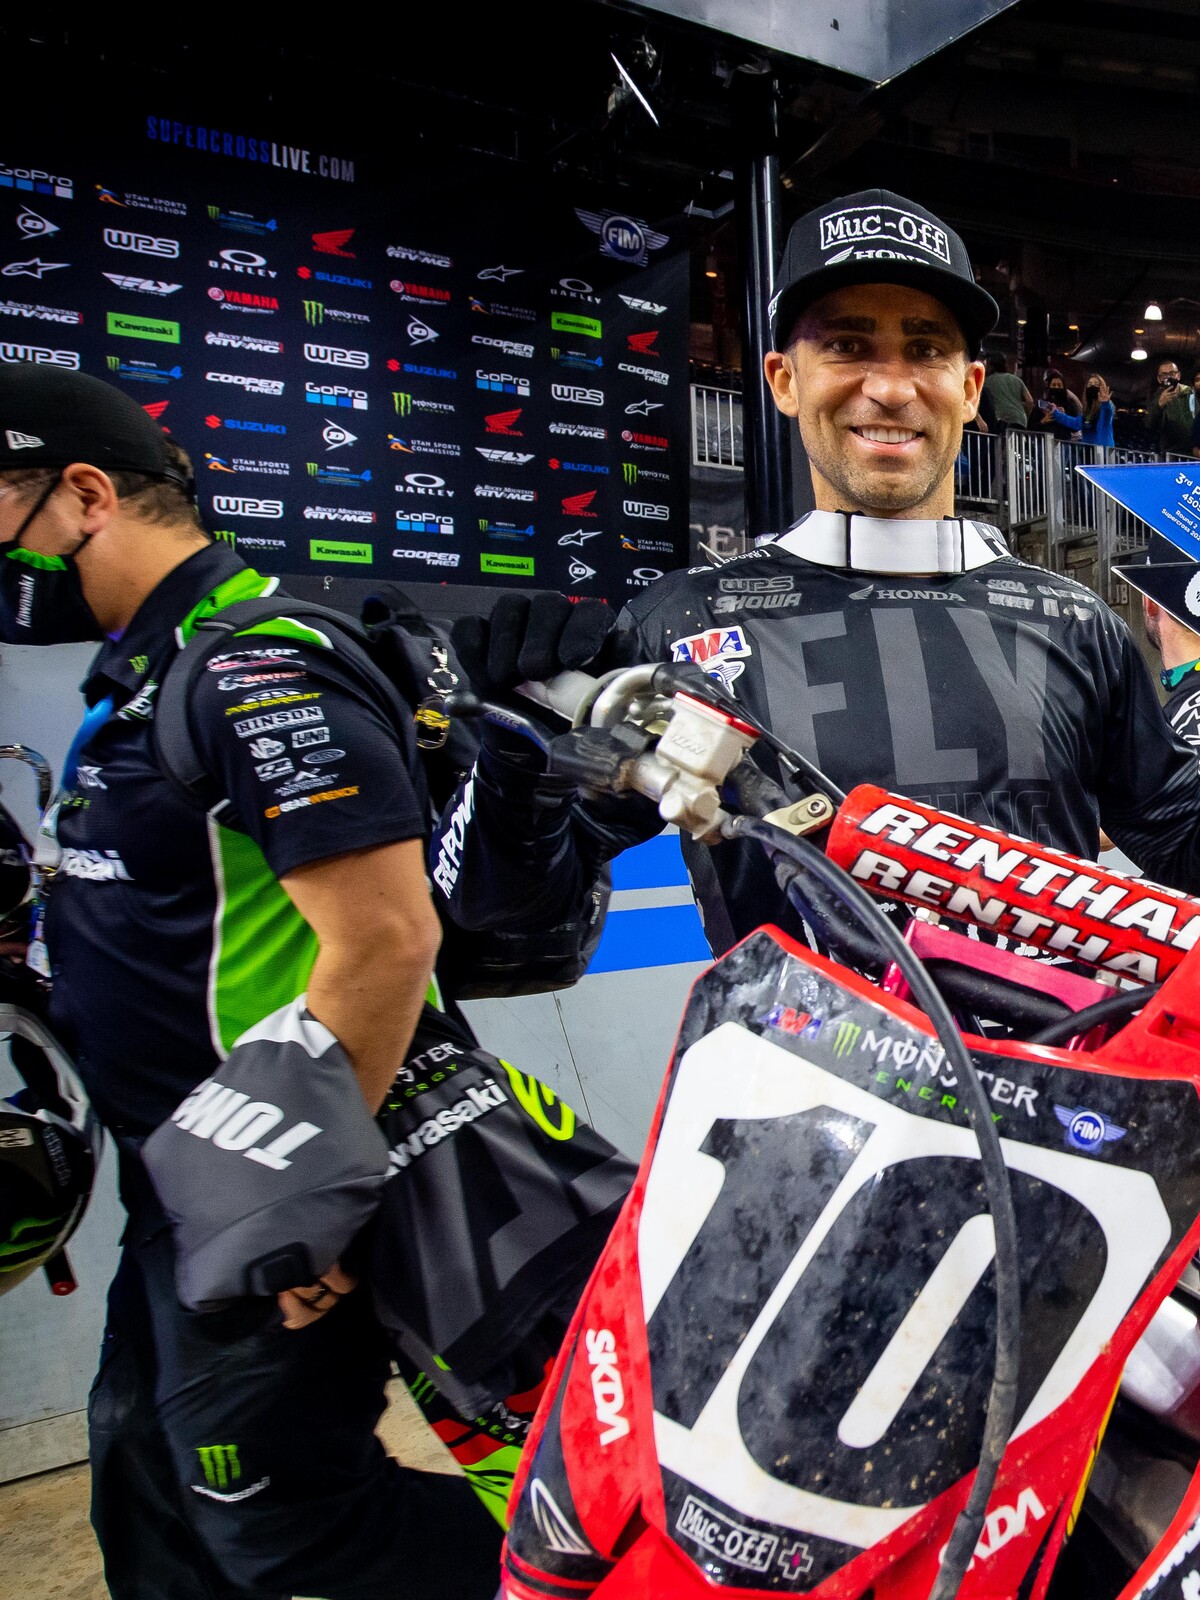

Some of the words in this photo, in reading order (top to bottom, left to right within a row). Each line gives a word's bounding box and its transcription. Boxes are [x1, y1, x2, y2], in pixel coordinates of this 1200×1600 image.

[147, 115, 354, 182] SUPERCROSSLIVE.COM
[103, 228, 179, 258] WPS
[608, 228, 639, 249] FIM
[825, 214, 949, 257] Muc-Off
[209, 260, 277, 278] OAKLEY
[315, 272, 372, 289] SUZUKI
[225, 289, 278, 310] YAMAHA
[405, 283, 450, 300] YAMAHA
[114, 319, 173, 336] Kawasaki
[556, 318, 598, 332] Kawasaki
[471, 335, 534, 351] COOPER
[305, 343, 369, 370] WPS
[404, 363, 456, 379] SUZUKI
[476, 370, 530, 387] GoPro
[618, 363, 669, 379] COOPER
[205, 371, 285, 389] COOPER
[306, 382, 368, 399] GoPro
[552, 384, 604, 406] WPS
[412, 399, 455, 412] MONSTER
[224, 419, 287, 434] SUZUKI
[411, 439, 430, 447] UTAH
[433, 442, 461, 451] SPORTS
[411, 445, 460, 456] COMMISSION
[232, 458, 254, 466] UTAH
[258, 461, 290, 469] SPORTS
[232, 464, 289, 476] COMMISSION
[562, 462, 610, 474] SUZUKI
[1175, 473, 1193, 486] 3rd
[395, 485, 455, 497] OAKLEY
[213, 496, 283, 518] WPS
[623, 500, 669, 520] WPS
[396, 510, 453, 526] GoPro
[1162, 509, 1190, 533] Supercross
[1175, 510, 1193, 525] Round
[237, 537, 286, 547] MONSTER
[316, 545, 367, 559] Kawasaki
[392, 549, 460, 563] COOPER
[486, 559, 529, 571] Kawasaki
[720, 575, 794, 594] WPS
[876, 590, 966, 602] HONDA
[672, 628, 747, 664] AMA
[745, 607, 1051, 790] FLY
[238, 708, 321, 733] HINSON
[850, 849, 1159, 983] RENTHA
[758, 1004, 825, 1040] AMA
[388, 1042, 464, 1084] STER
[875, 1071, 1002, 1123] ENERY
[385, 1078, 509, 1177] wasaki
[1074, 1122, 1101, 1142] FIM
[645, 1105, 1108, 1508] 10
[584, 1328, 630, 1446] SKDA
[682, 1502, 774, 1568] Muc-Off
